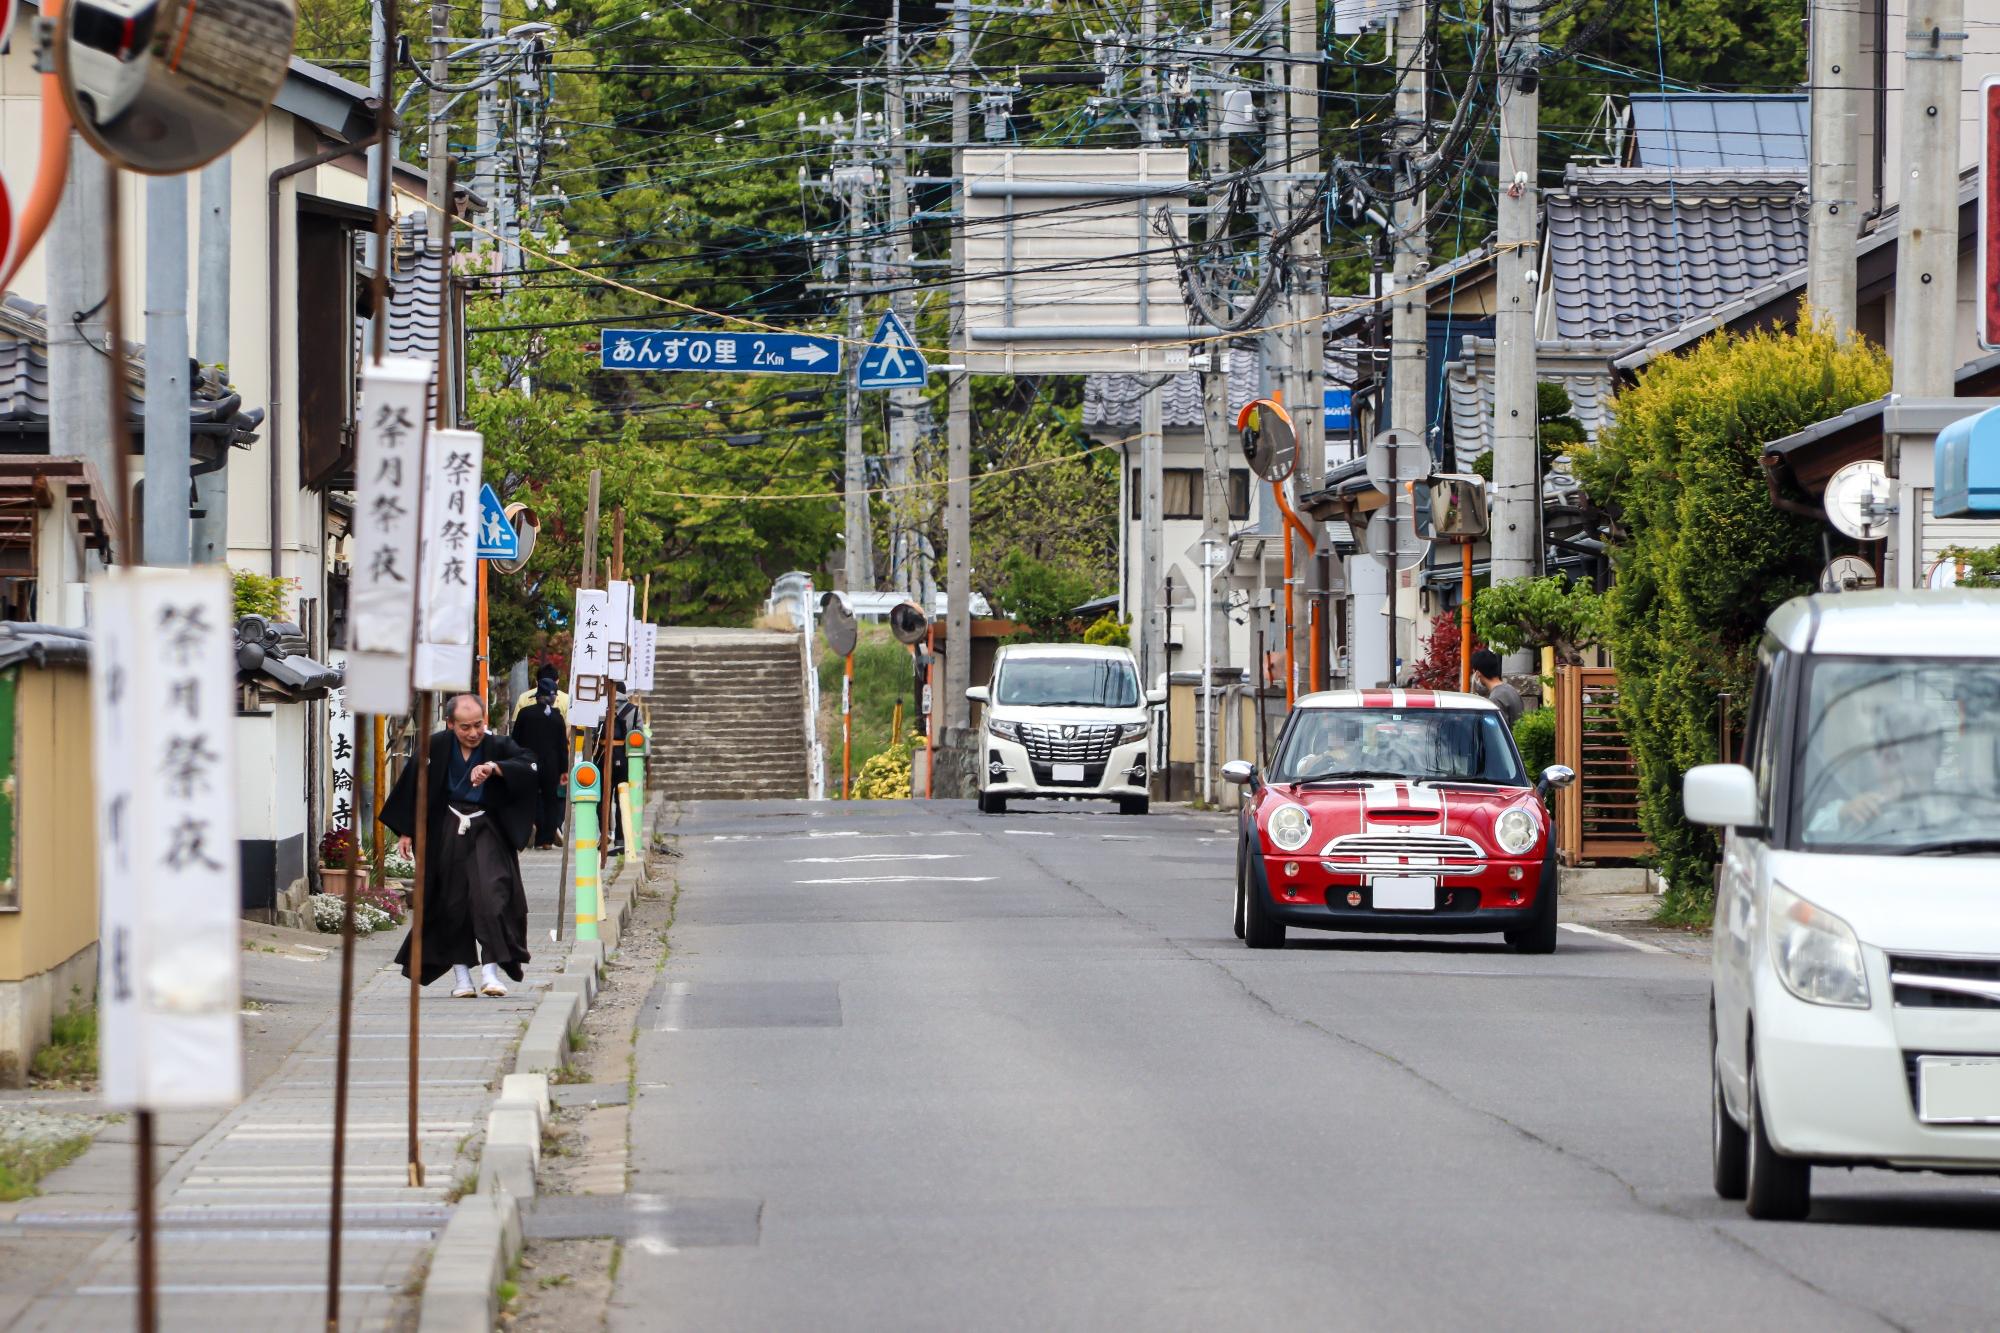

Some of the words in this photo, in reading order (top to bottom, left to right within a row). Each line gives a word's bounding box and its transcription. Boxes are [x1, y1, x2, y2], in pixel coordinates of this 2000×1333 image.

[611, 336, 738, 364] あんずの里
[440, 450, 475, 587] 祭月祭夜
[584, 603, 599, 660] 令和五年
